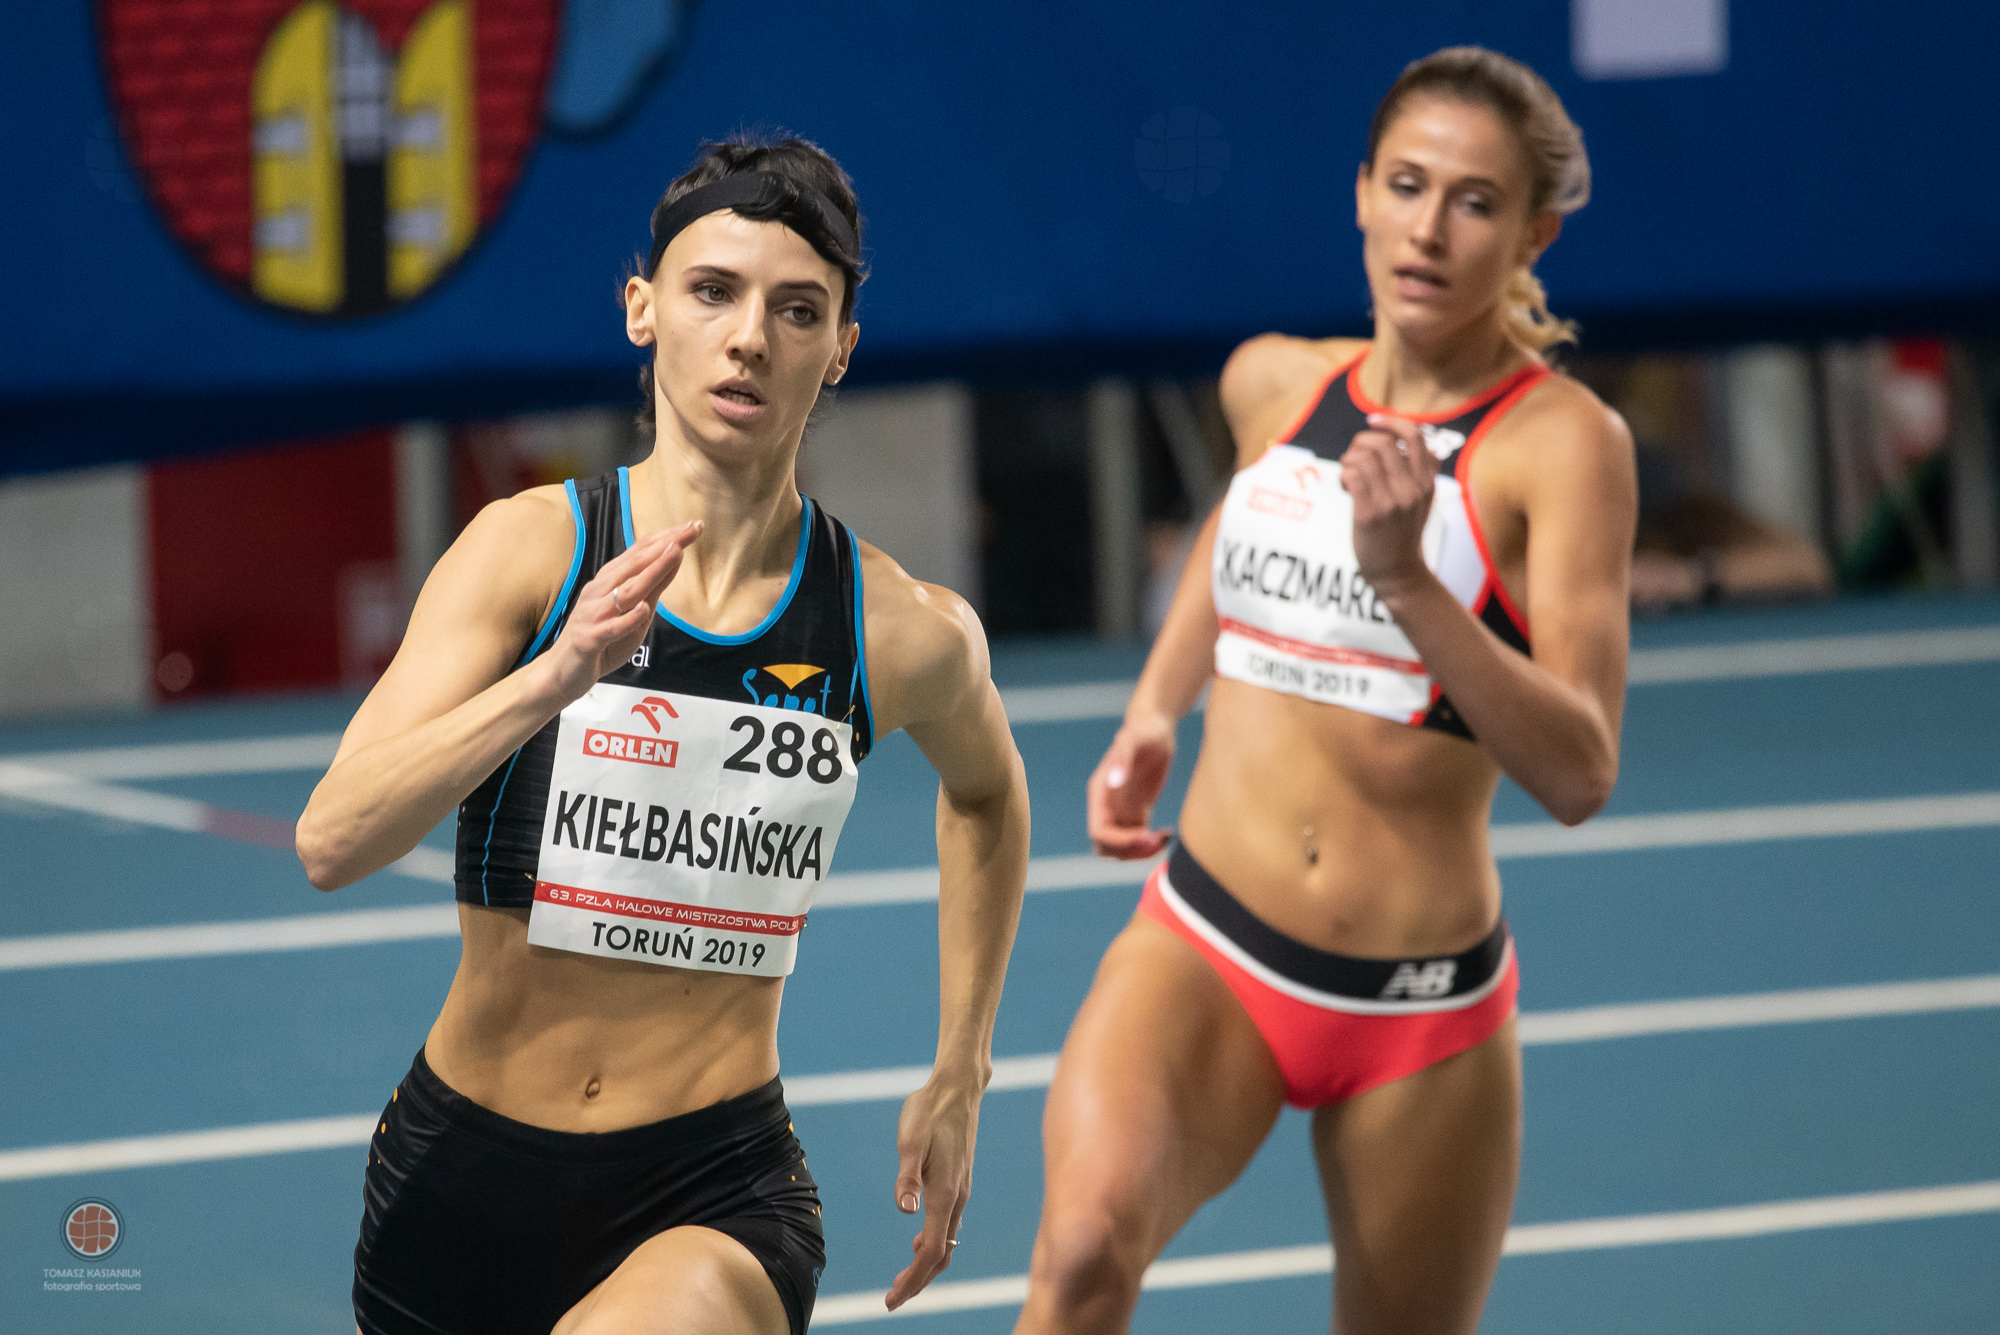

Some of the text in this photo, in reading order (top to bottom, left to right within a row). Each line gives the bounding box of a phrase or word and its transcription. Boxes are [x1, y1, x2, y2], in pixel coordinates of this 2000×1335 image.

[588, 733, 673, 764] ORLEN
[723, 715, 843, 784] 288
[552, 789, 824, 882] KIEŁBASIŃSKA
[549, 888, 572, 902] 63.
[575, 893, 612, 909] PZLA
[615, 900, 673, 917] HALOWE
[676, 909, 767, 929] MISTRZOSTWA
[592, 921, 766, 969] TORUŃ 2019
